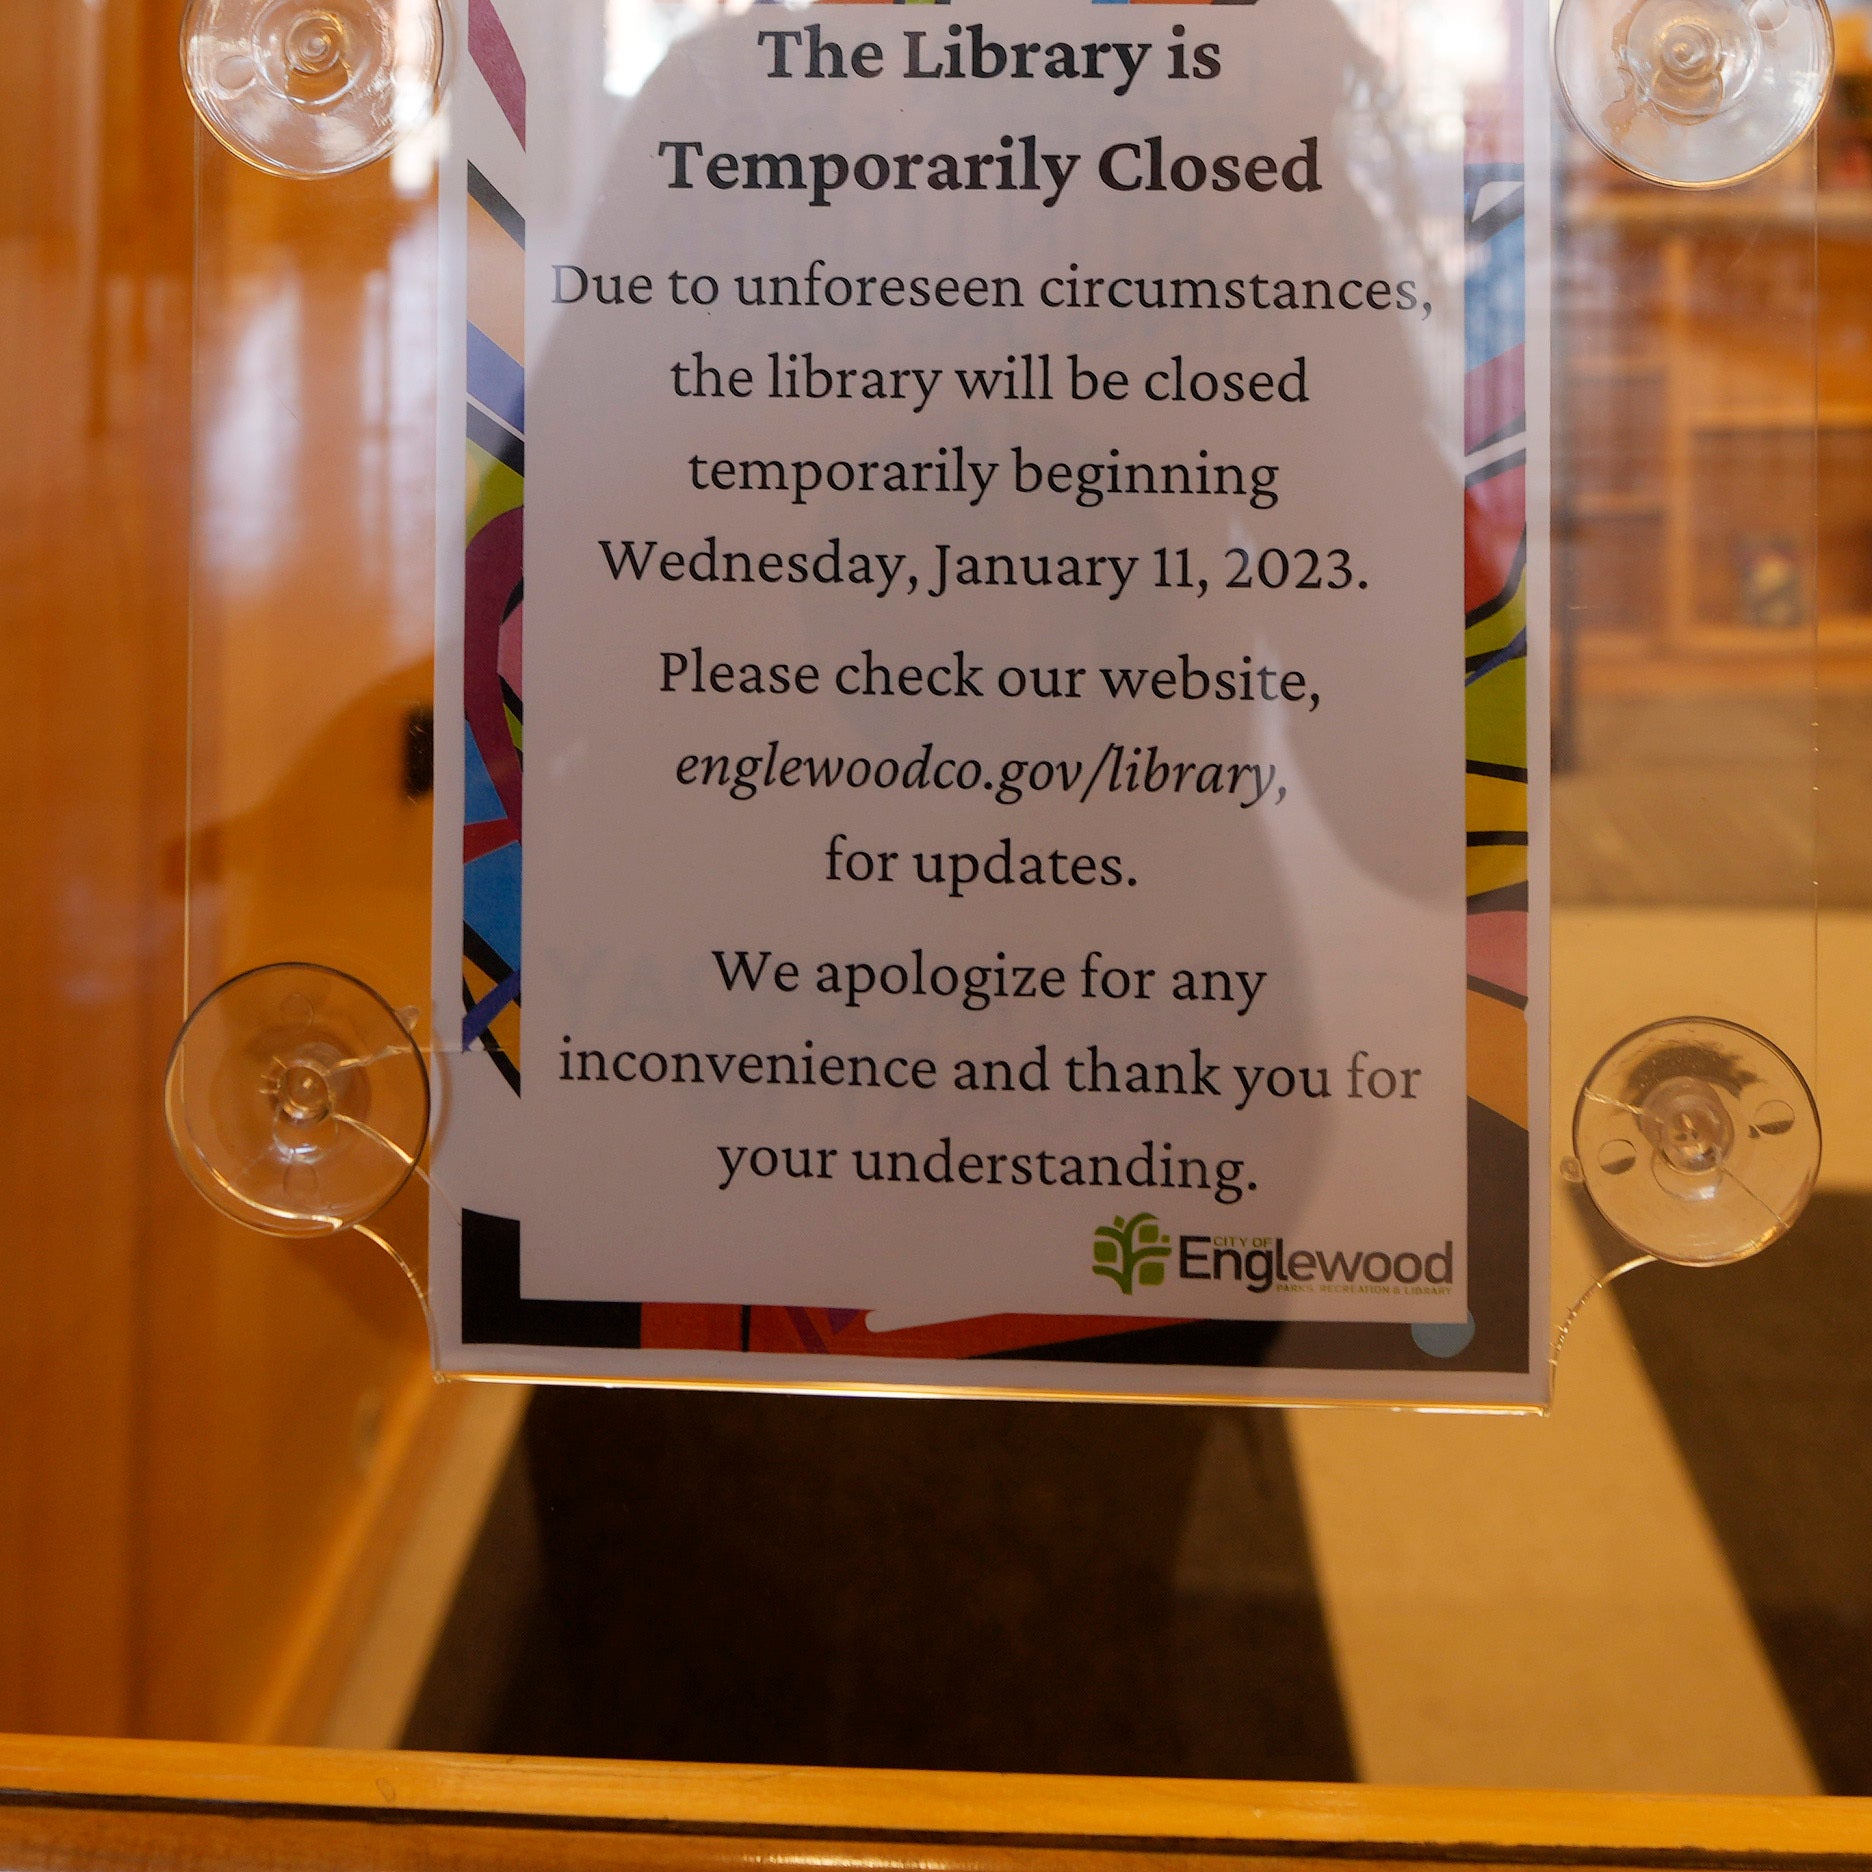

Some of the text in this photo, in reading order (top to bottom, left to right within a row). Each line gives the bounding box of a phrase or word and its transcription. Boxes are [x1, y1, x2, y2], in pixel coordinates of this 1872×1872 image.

[756, 22, 1222, 98] The Library is
[657, 133, 1324, 209] Temporarily Closed
[551, 258, 1433, 321] Due to unforeseen circumstances,
[669, 350, 1311, 415] the library will be closed
[687, 444, 1280, 511] temporarily beginning
[597, 534, 1369, 602] Wednesday, January 11, 2023.
[659, 645, 1321, 713] Please check our website,
[675, 739, 1287, 810] englewoodco.gov/library,
[824, 832, 1138, 899] for updates.
[710, 949, 800, 993] We
[815, 947, 1066, 1012] apologize
[1079, 950, 1157, 1000] for
[1171, 969, 1269, 1018] any
[558, 1034, 1422, 1112] inconvenience and thank you for
[716, 1135, 1258, 1206] your understanding.
[1178, 1234, 1454, 1295] Englewood
[1211, 1234, 1275, 1249] CITY OF
